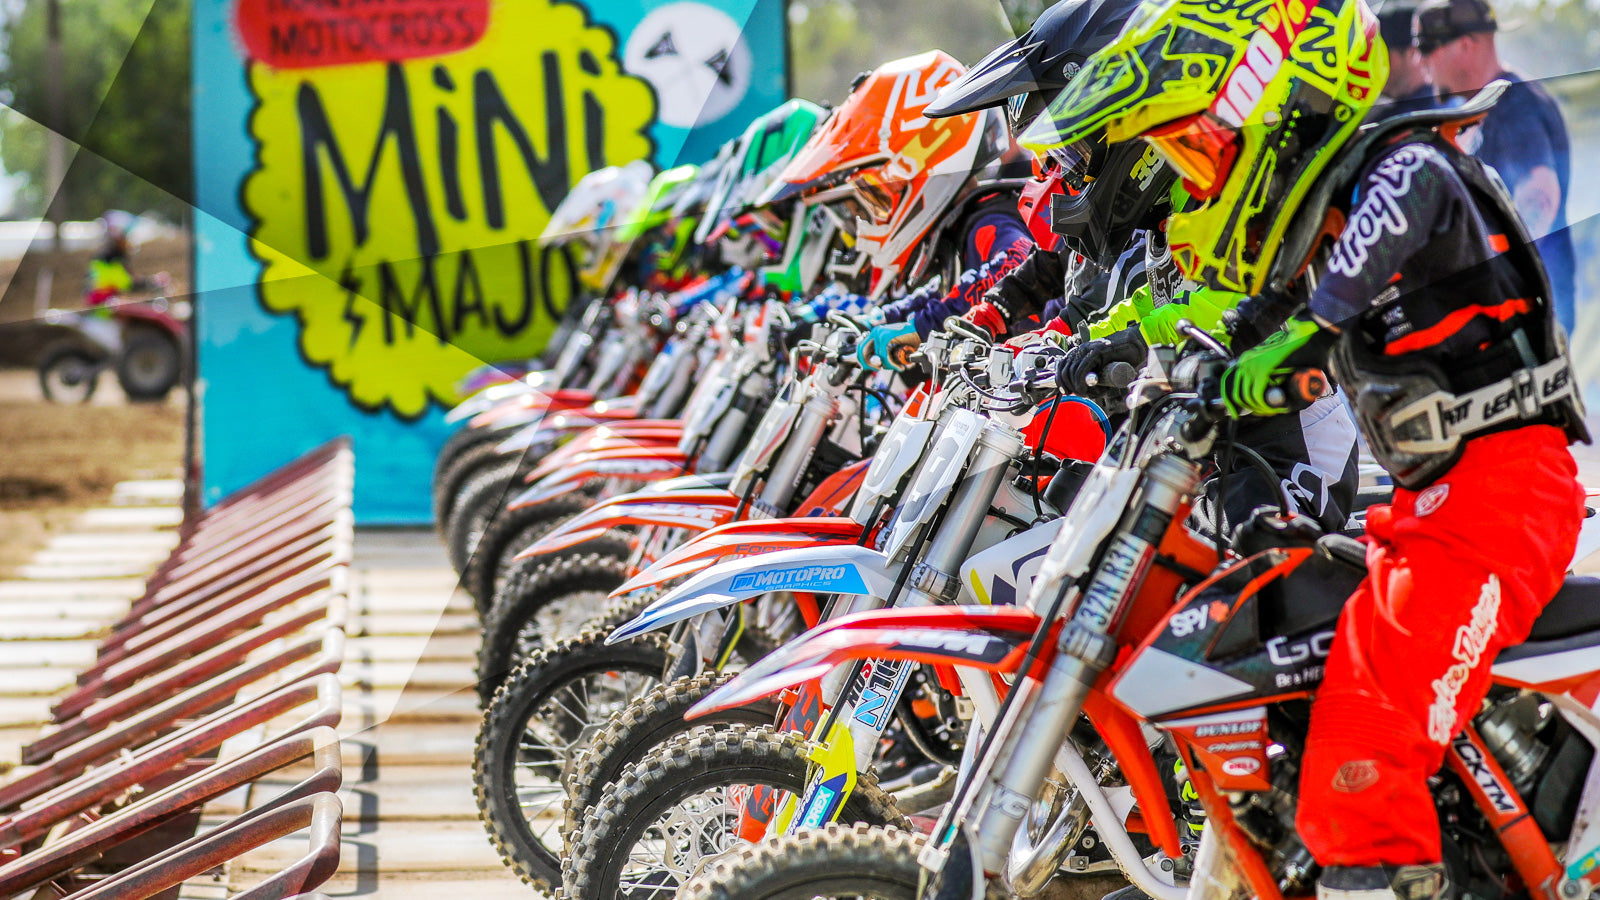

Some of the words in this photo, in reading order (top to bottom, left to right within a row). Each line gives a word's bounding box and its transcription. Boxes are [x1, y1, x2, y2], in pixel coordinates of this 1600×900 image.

[269, 8, 475, 56] MOTOCROSS
[1129, 143, 1166, 192] 39
[764, 581, 832, 591] GRAPHICS
[1169, 603, 1209, 637] SPY
[1195, 721, 1263, 737] DUNLOP
